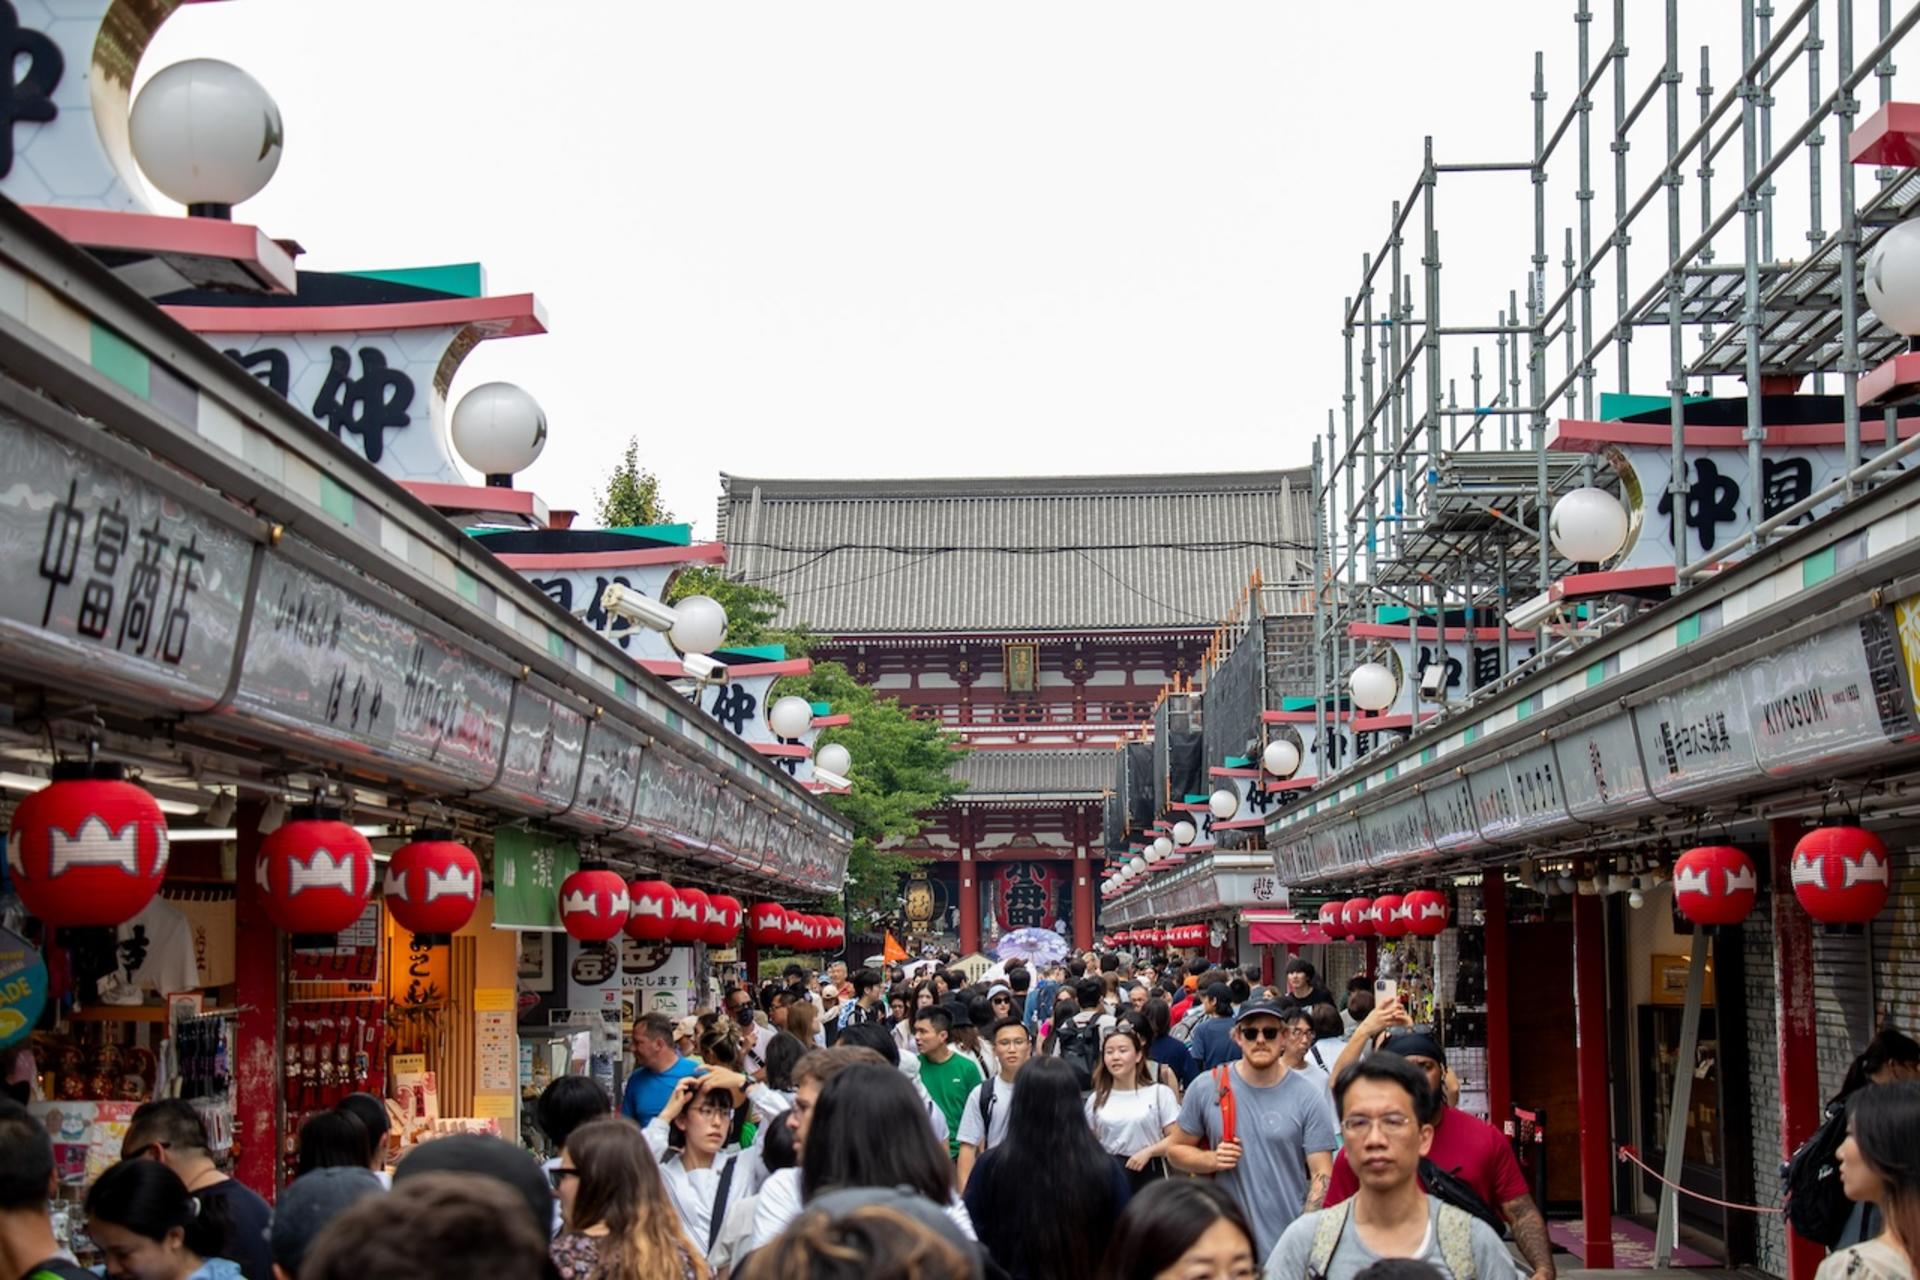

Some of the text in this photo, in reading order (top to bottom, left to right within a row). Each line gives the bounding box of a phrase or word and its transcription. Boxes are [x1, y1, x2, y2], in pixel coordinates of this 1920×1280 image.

[39, 479, 205, 664] 中富商店
[1763, 686, 1829, 736] KIYOSUMI
[622, 975, 680, 987] いたします
